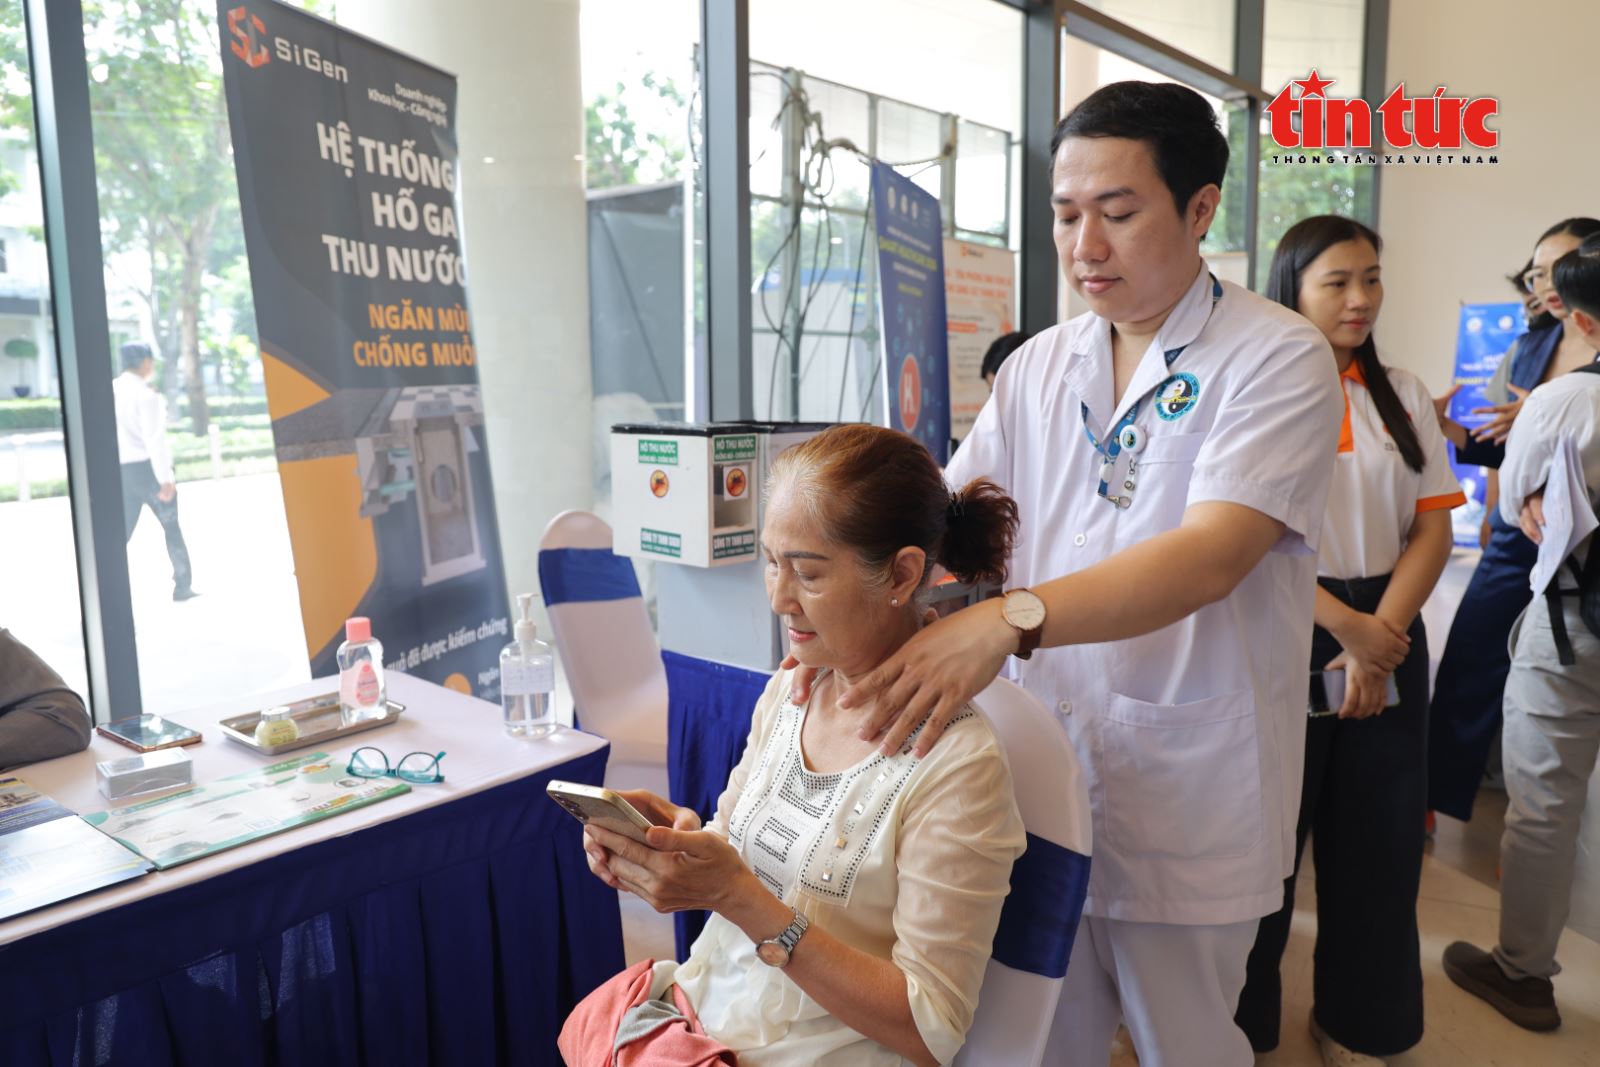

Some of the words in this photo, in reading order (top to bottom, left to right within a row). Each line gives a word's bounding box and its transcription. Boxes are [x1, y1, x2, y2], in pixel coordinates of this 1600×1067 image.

[274, 36, 349, 84] SiGen
[368, 88, 391, 106] Khoa
[316, 120, 355, 178] HỆ
[358, 136, 456, 194] THỐNG
[371, 187, 420, 231] HỐ
[423, 202, 459, 240] GA
[322, 234, 380, 279] THU
[368, 298, 434, 331] NGĂN
[353, 334, 428, 367] CHỐNG
[421, 639, 447, 661] được
[477, 617, 508, 641] chứng
